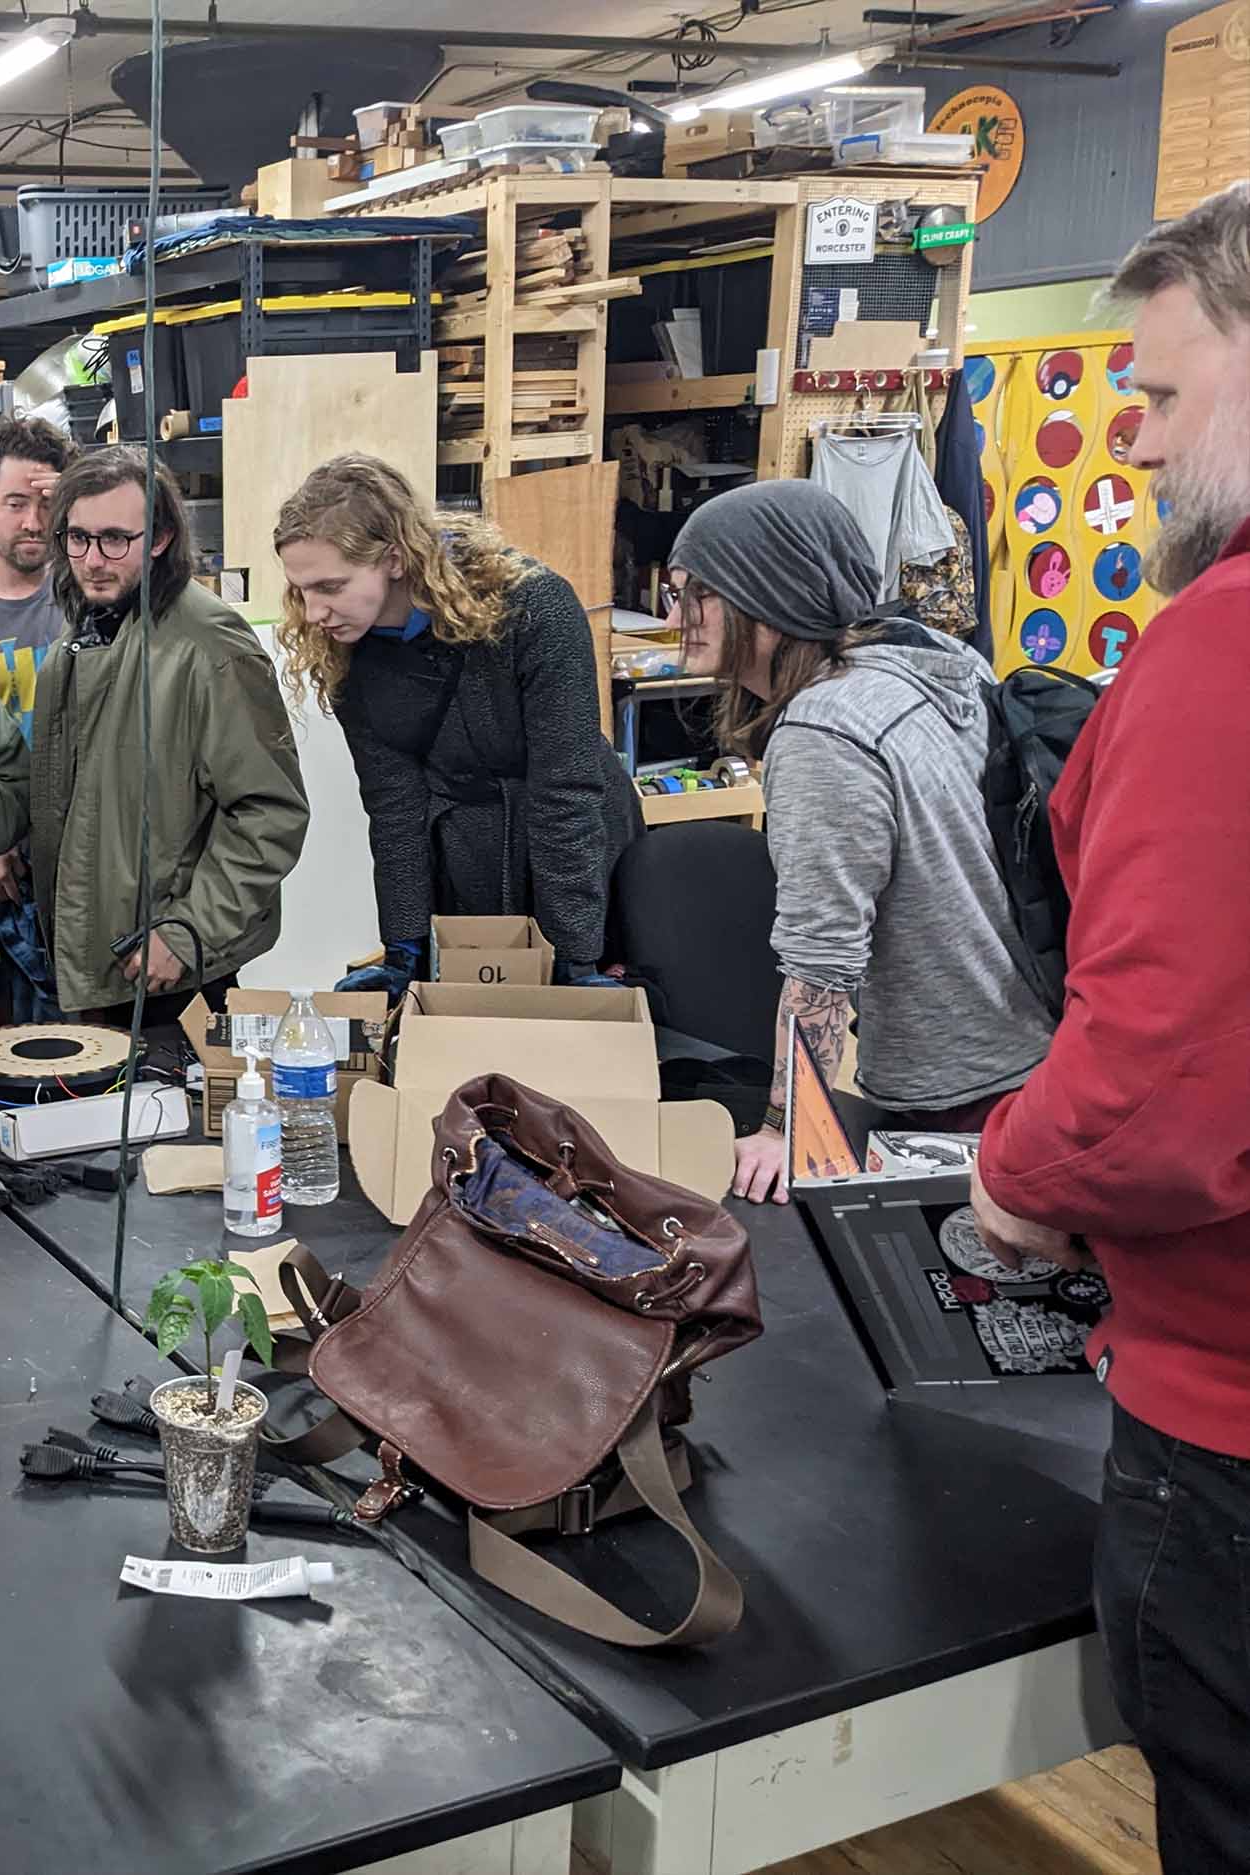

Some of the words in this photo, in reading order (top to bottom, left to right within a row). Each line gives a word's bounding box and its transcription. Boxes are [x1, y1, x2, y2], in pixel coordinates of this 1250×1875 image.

[816, 205, 870, 223] ENTERING
[816, 243, 866, 253] WORCESTER
[929, 1272, 961, 1310] 2024
